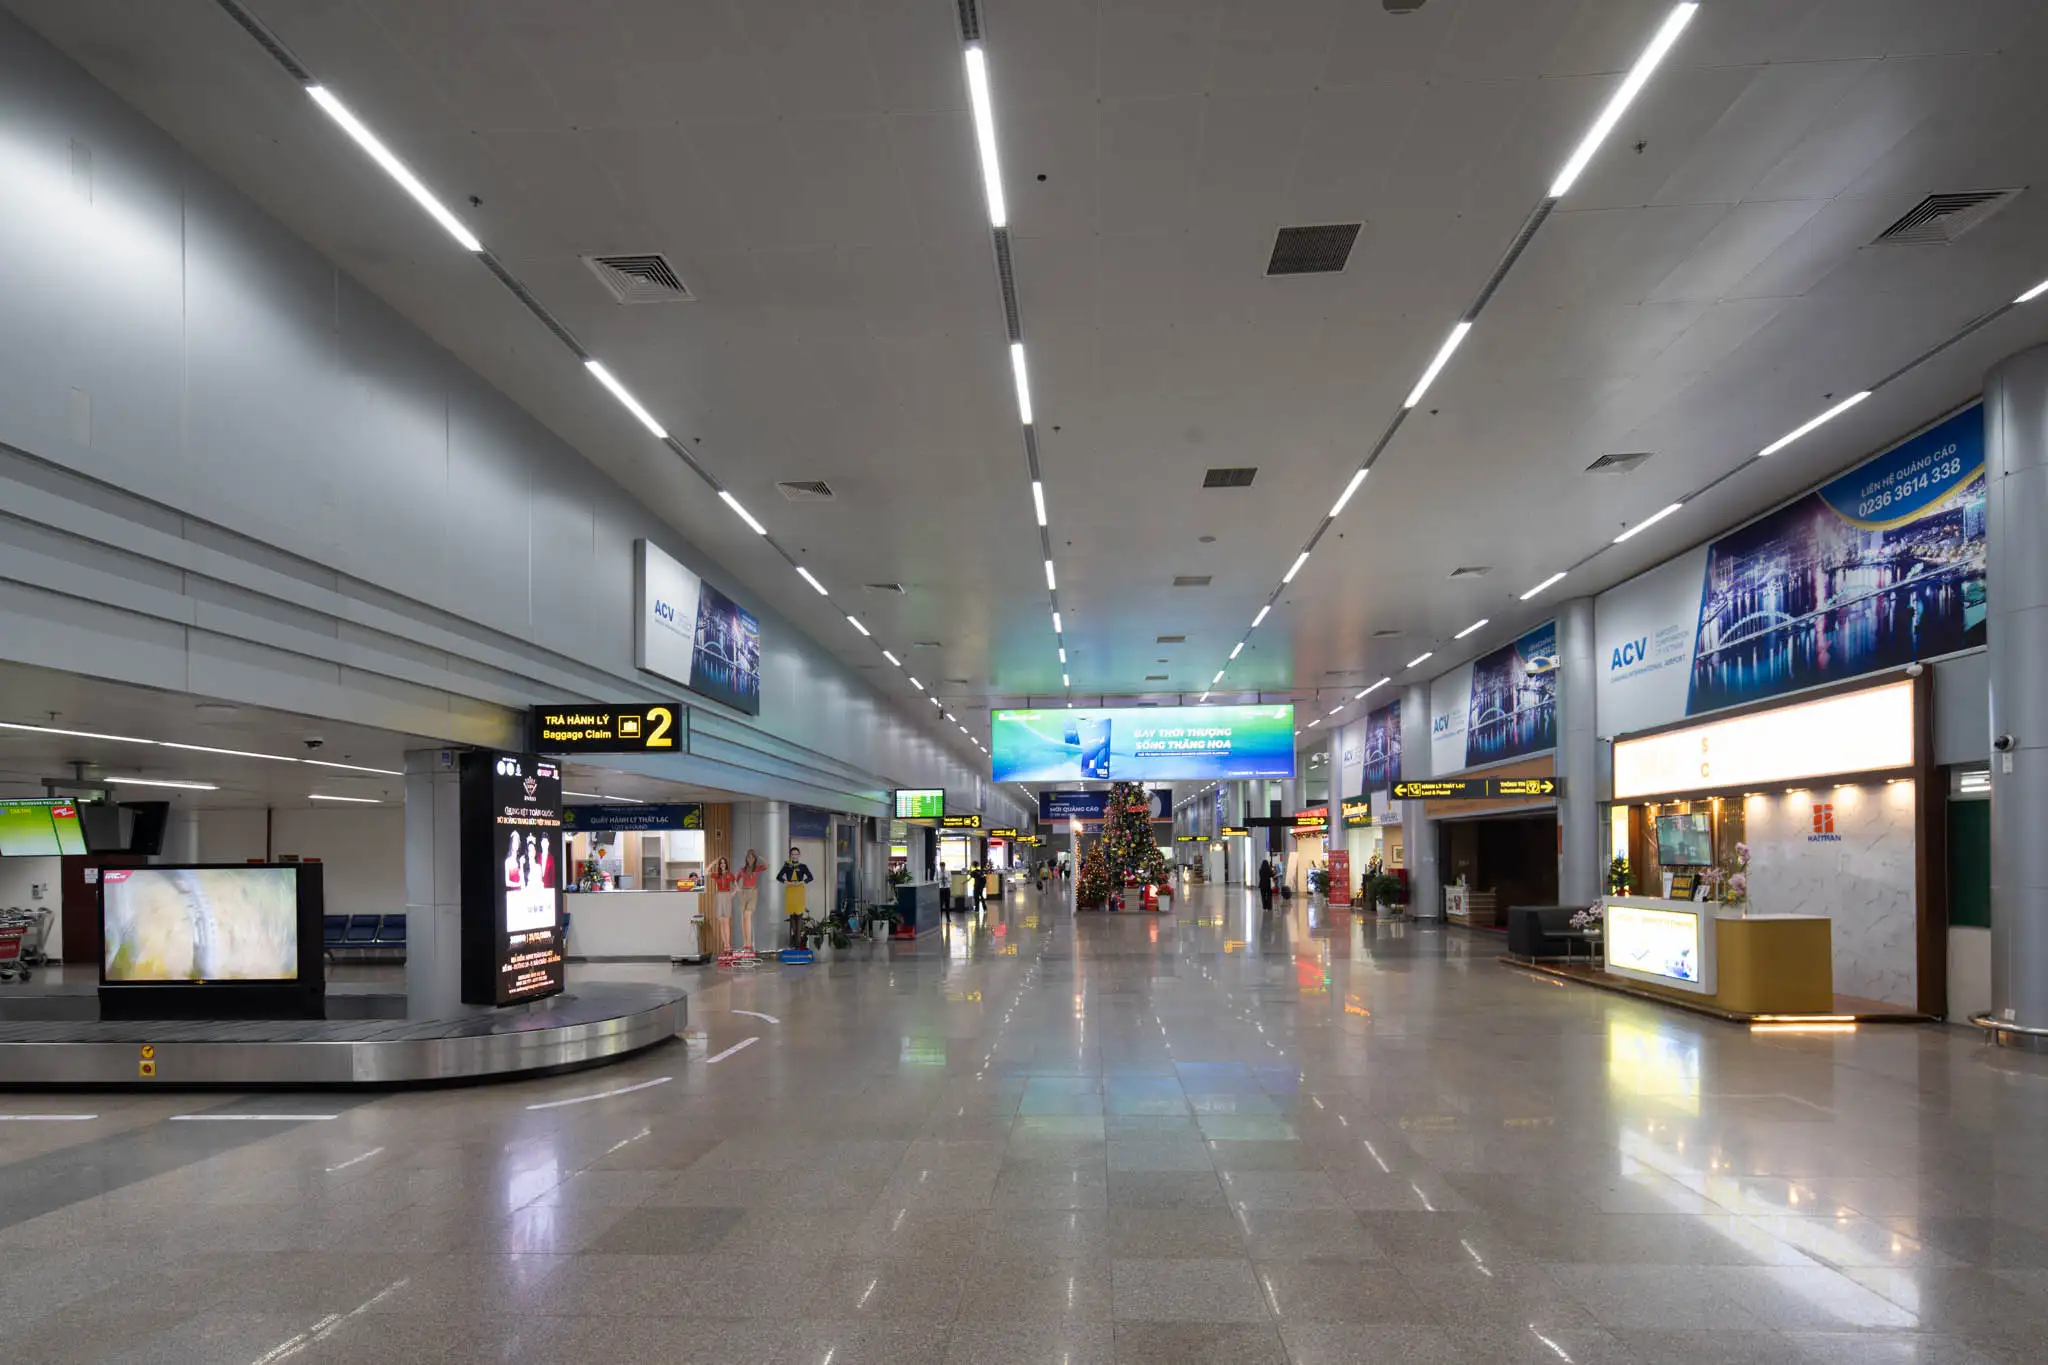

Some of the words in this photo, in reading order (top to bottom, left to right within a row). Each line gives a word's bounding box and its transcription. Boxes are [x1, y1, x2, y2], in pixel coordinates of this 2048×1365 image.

[1861, 481, 1881, 497] LIÊN
[1882, 472, 1895, 489] HỆ
[1896, 456, 1932, 480] QUẢNG
[1933, 443, 1957, 462] CÁO
[1858, 491, 1892, 517] 0236
[1894, 473, 1929, 501] 3614
[1931, 457, 1961, 483] 338
[654, 599, 674, 622] ACV
[1611, 636, 1648, 670] ACV
[545, 713, 565, 725] TRẢ
[567, 714, 595, 725] HÀNH
[597, 713, 610, 725] LÝ
[646, 707, 673, 747] 2
[1433, 713, 1449, 734] ACV
[543, 730, 583, 741] Baggage
[585, 730, 612, 739] Claim
[1207, 740, 1232, 749] HOA
[1063, 804, 1085, 813] QUẢNG
[1086, 804, 1099, 812] CÁO
[609, 815, 630, 824] HÀNH
[971, 815, 980, 828] 3
